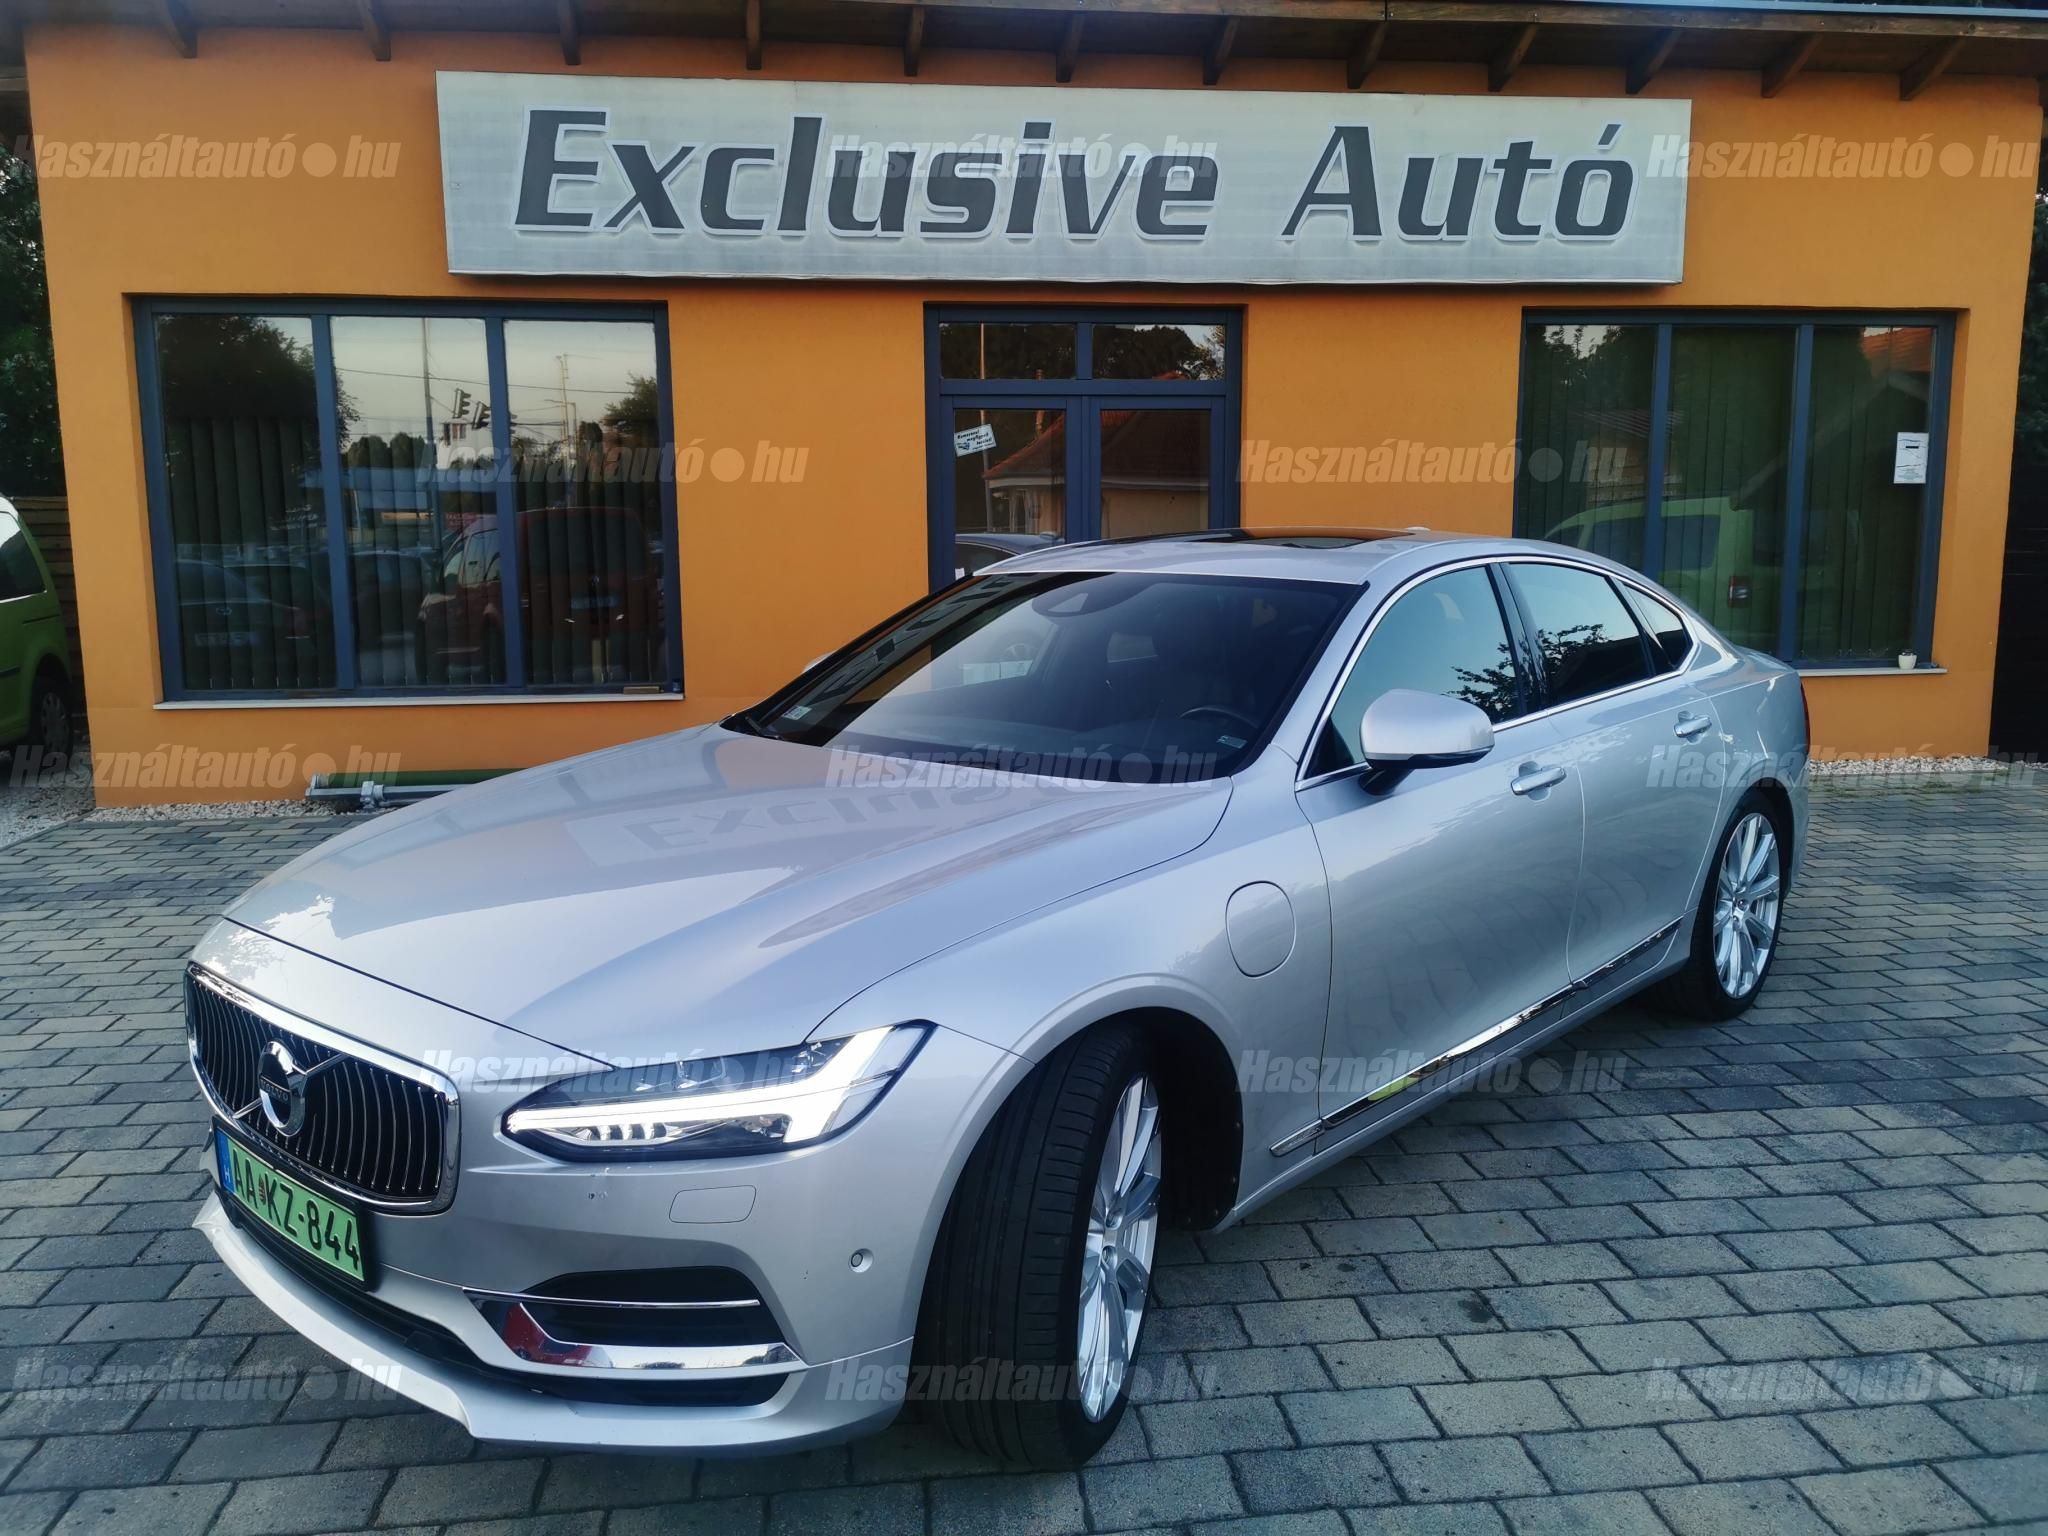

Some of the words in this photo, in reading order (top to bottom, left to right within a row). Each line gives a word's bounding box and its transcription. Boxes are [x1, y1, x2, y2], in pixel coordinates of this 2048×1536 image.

[513, 108, 1219, 237] Exclusive
[1279, 122, 1636, 238] Autó
[259, 1079, 289, 1102] VOLVO
[232, 1148, 258, 1210] AA
[264, 1172, 360, 1271] KZ-844
